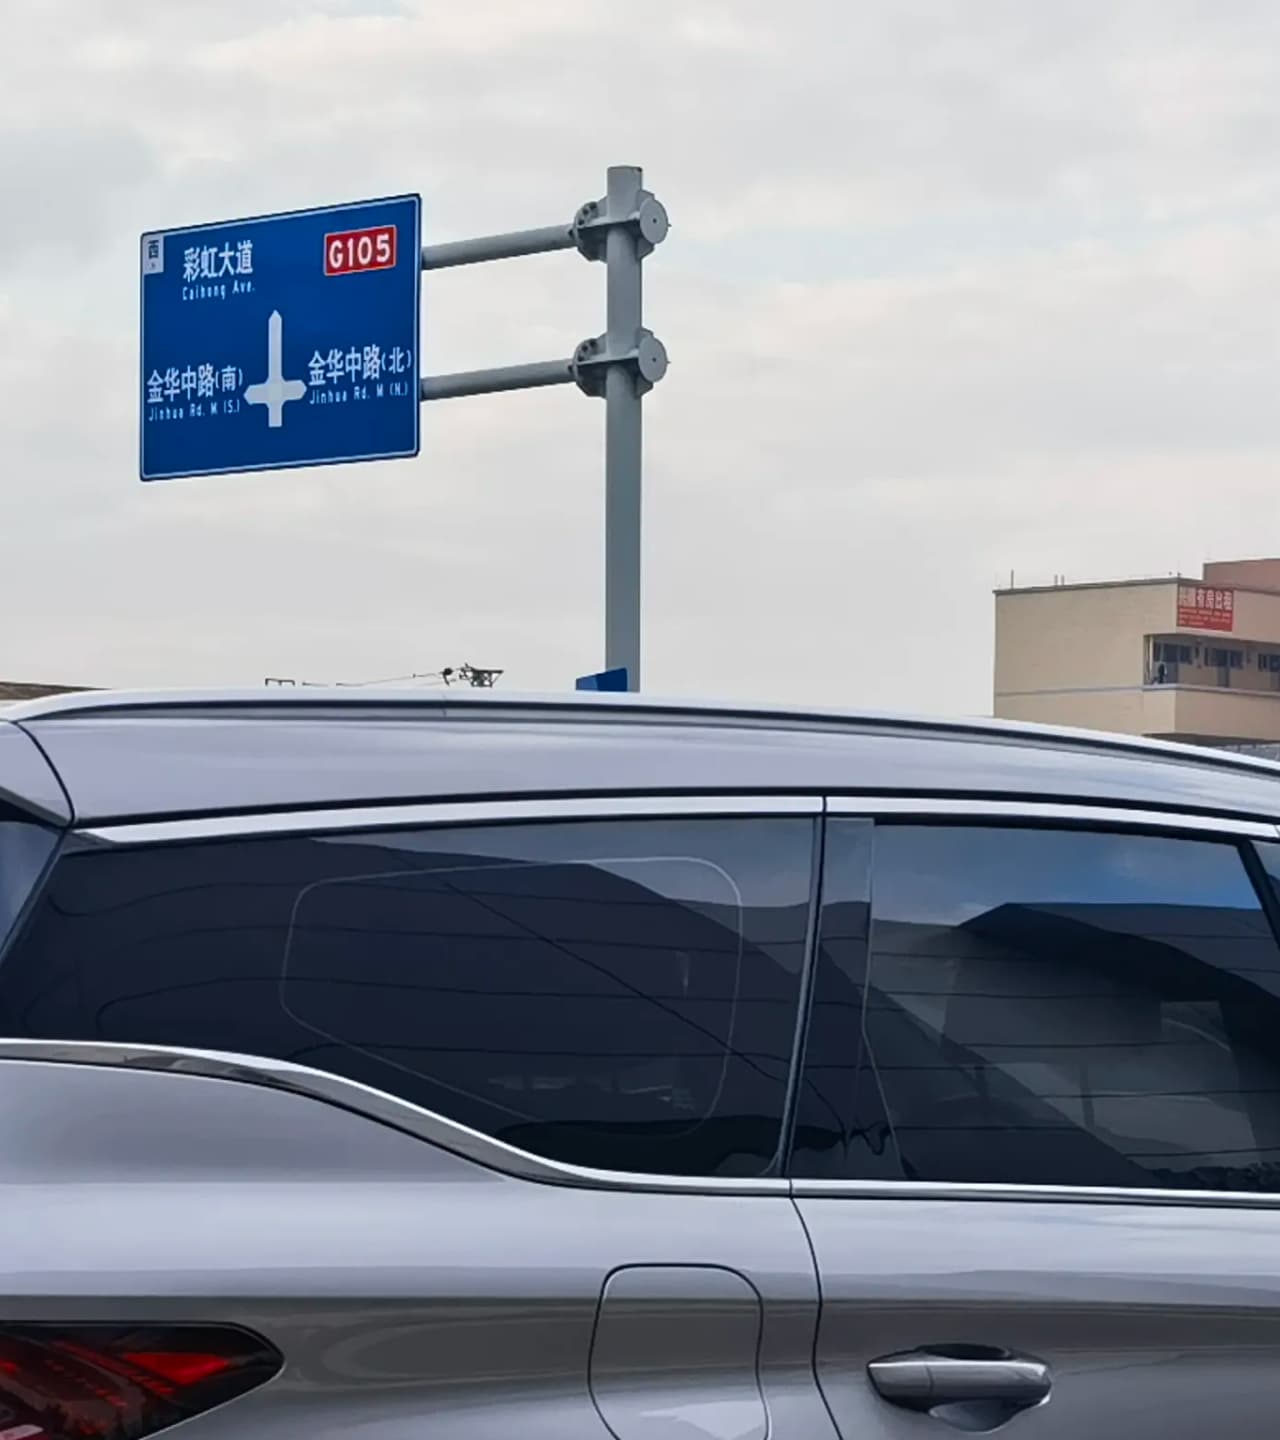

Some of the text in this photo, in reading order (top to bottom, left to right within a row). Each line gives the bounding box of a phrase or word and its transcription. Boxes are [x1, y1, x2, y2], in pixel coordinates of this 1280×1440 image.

[183, 240, 253, 283] 彩虹大道
[329, 233, 391, 269] G105
[183, 284, 226, 301] Caihong
[308, 343, 412, 386] 金华中路(北)
[147, 363, 243, 404] 金华中路(南)
[309, 389, 347, 405] Jinhua
[149, 407, 184, 422] Jinhua
